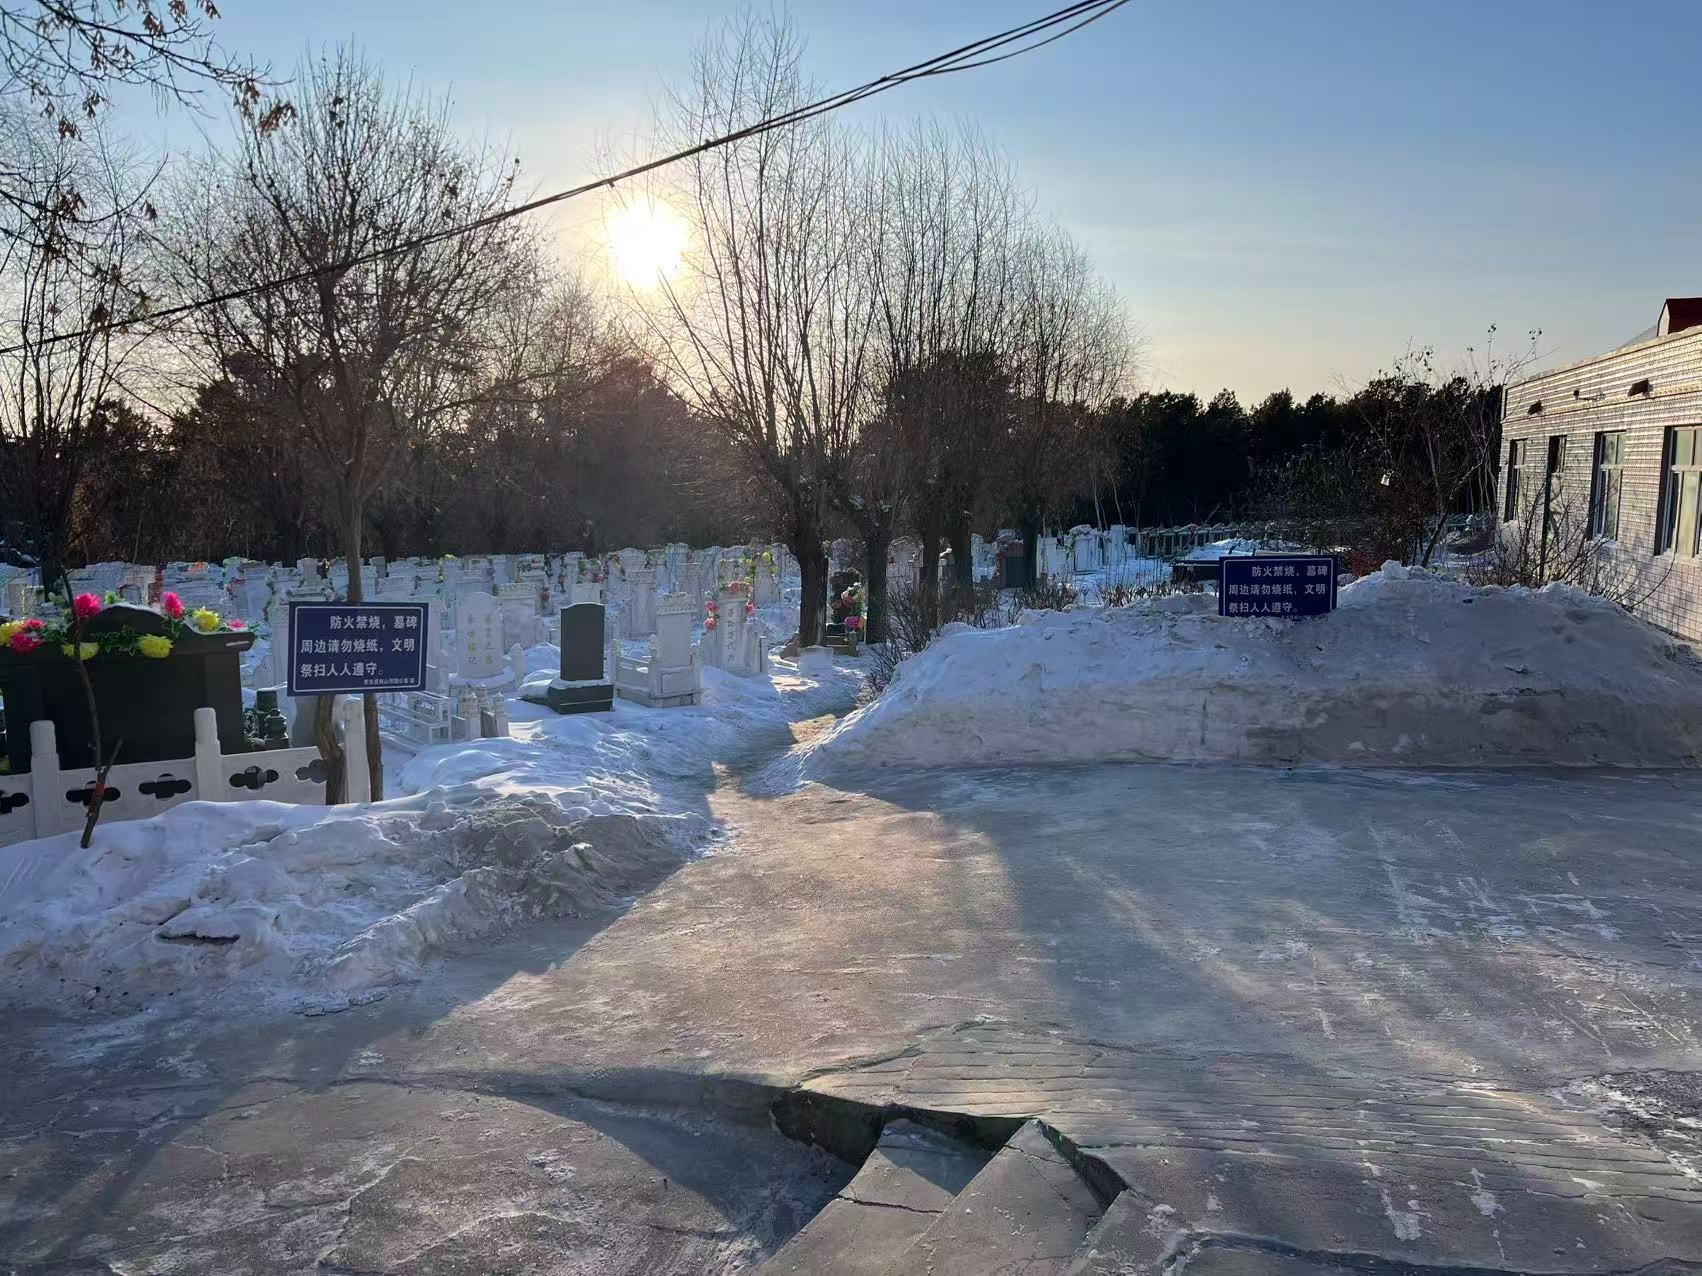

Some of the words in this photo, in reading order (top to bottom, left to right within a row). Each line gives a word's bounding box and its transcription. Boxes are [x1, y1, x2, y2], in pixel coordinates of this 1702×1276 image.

[1228, 602, 1298, 613] 祭扫人人遵守。
[330, 615, 418, 630] 防火禁烧，墓碑
[300, 638, 415, 653] 周边请勿烧纸，文明
[300, 662, 384, 677] 祭扫人人遵守。
